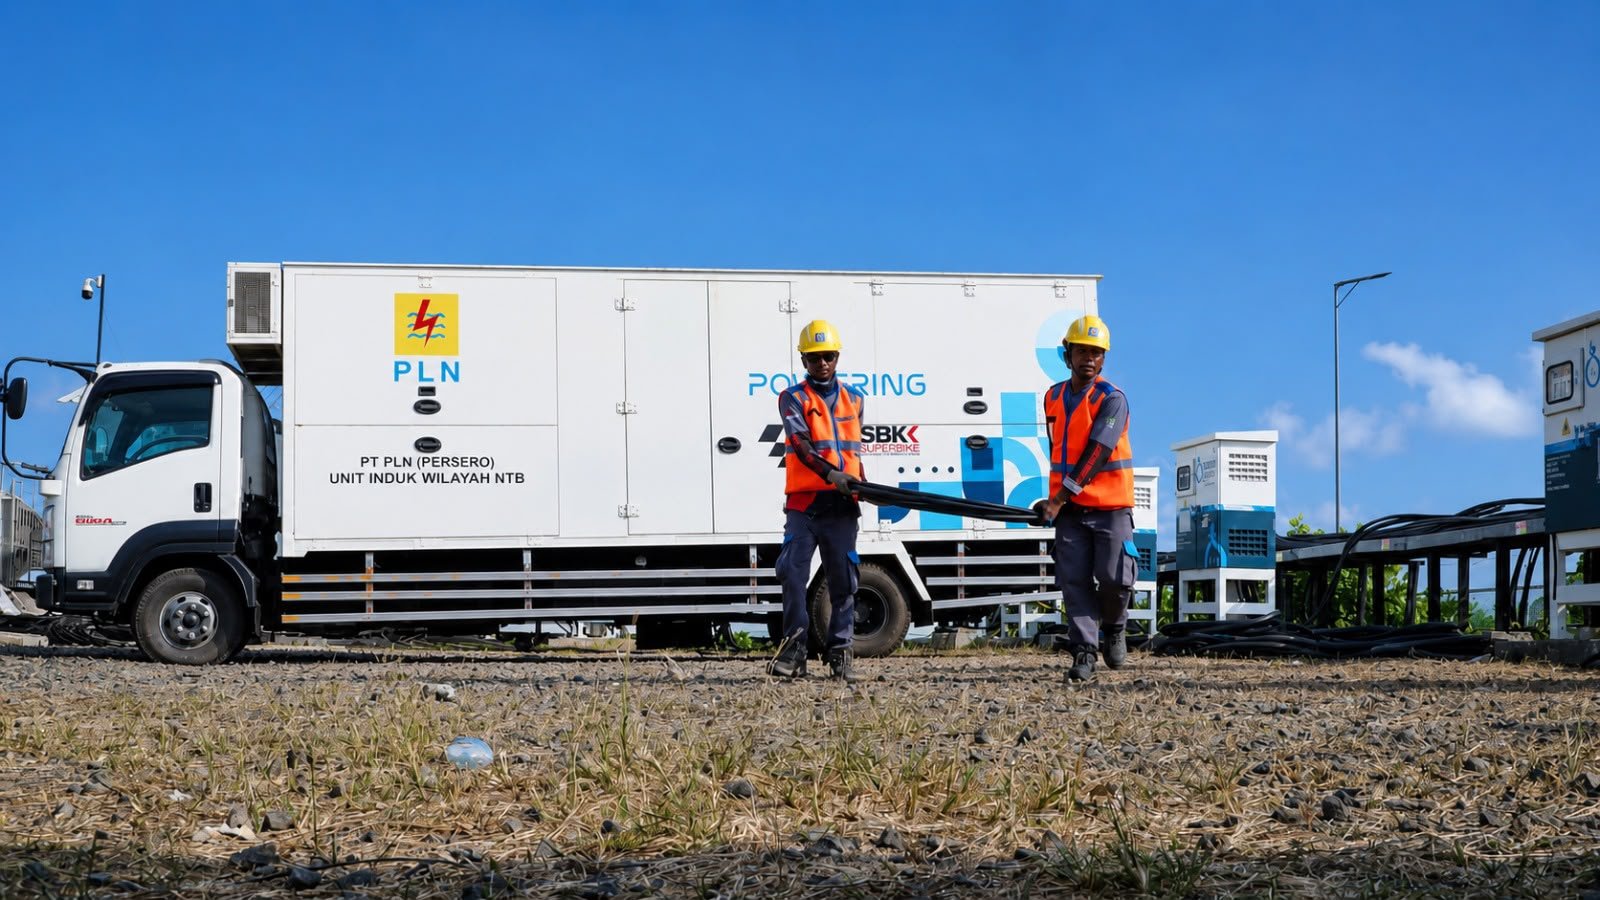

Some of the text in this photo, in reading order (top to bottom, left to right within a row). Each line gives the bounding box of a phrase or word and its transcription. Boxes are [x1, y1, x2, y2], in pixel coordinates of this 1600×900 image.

[393, 360, 460, 383] PLN
[748, 372, 927, 397] PORING
[860, 425, 909, 443] SBK
[860, 443, 920, 453] SUPERBIKE
[360, 456, 495, 470] PT PLN (PERSERO)
[329, 472, 525, 484] UNIT INDUK WILAYAH NTB
